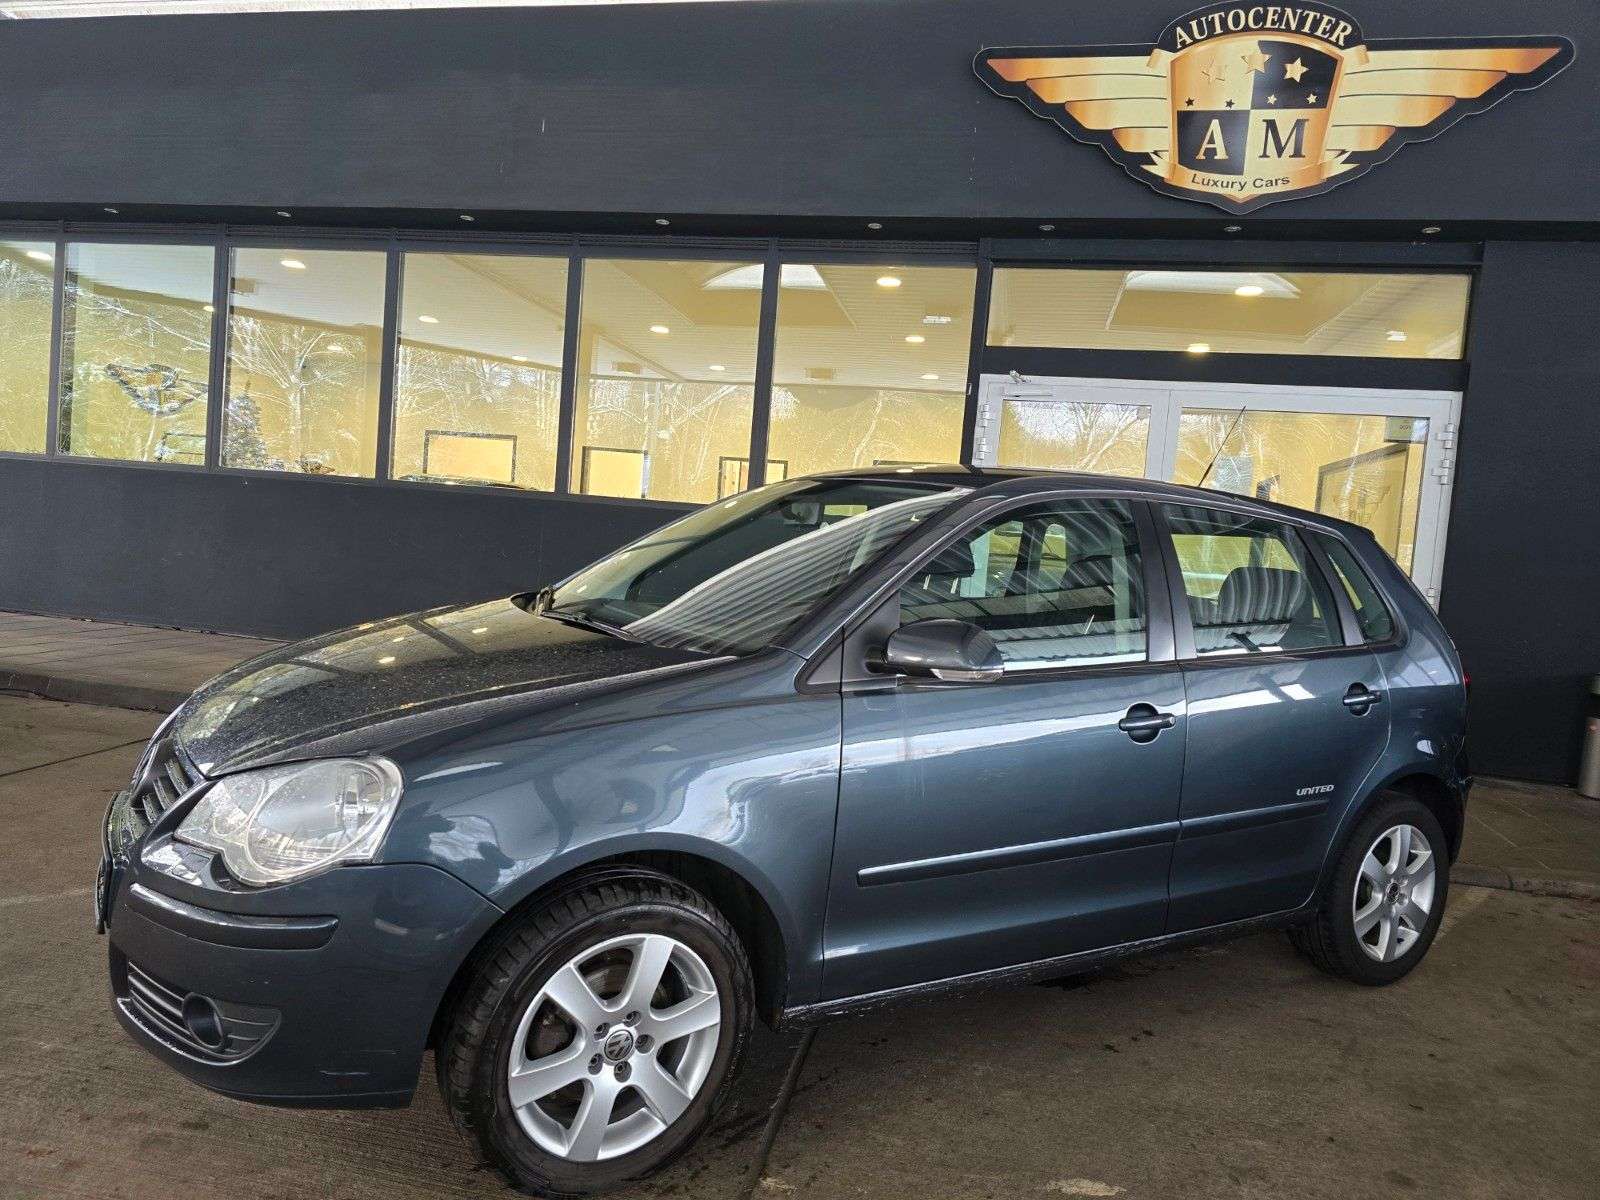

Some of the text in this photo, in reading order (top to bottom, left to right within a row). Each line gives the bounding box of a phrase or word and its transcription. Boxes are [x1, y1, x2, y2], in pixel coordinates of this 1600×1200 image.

[1175, 6, 1353, 49] AUTOCENTER
[1195, 118, 1310, 160] A M
[1191, 173, 1291, 192] Luxury Cars
[1296, 784, 1335, 796] UNITED
